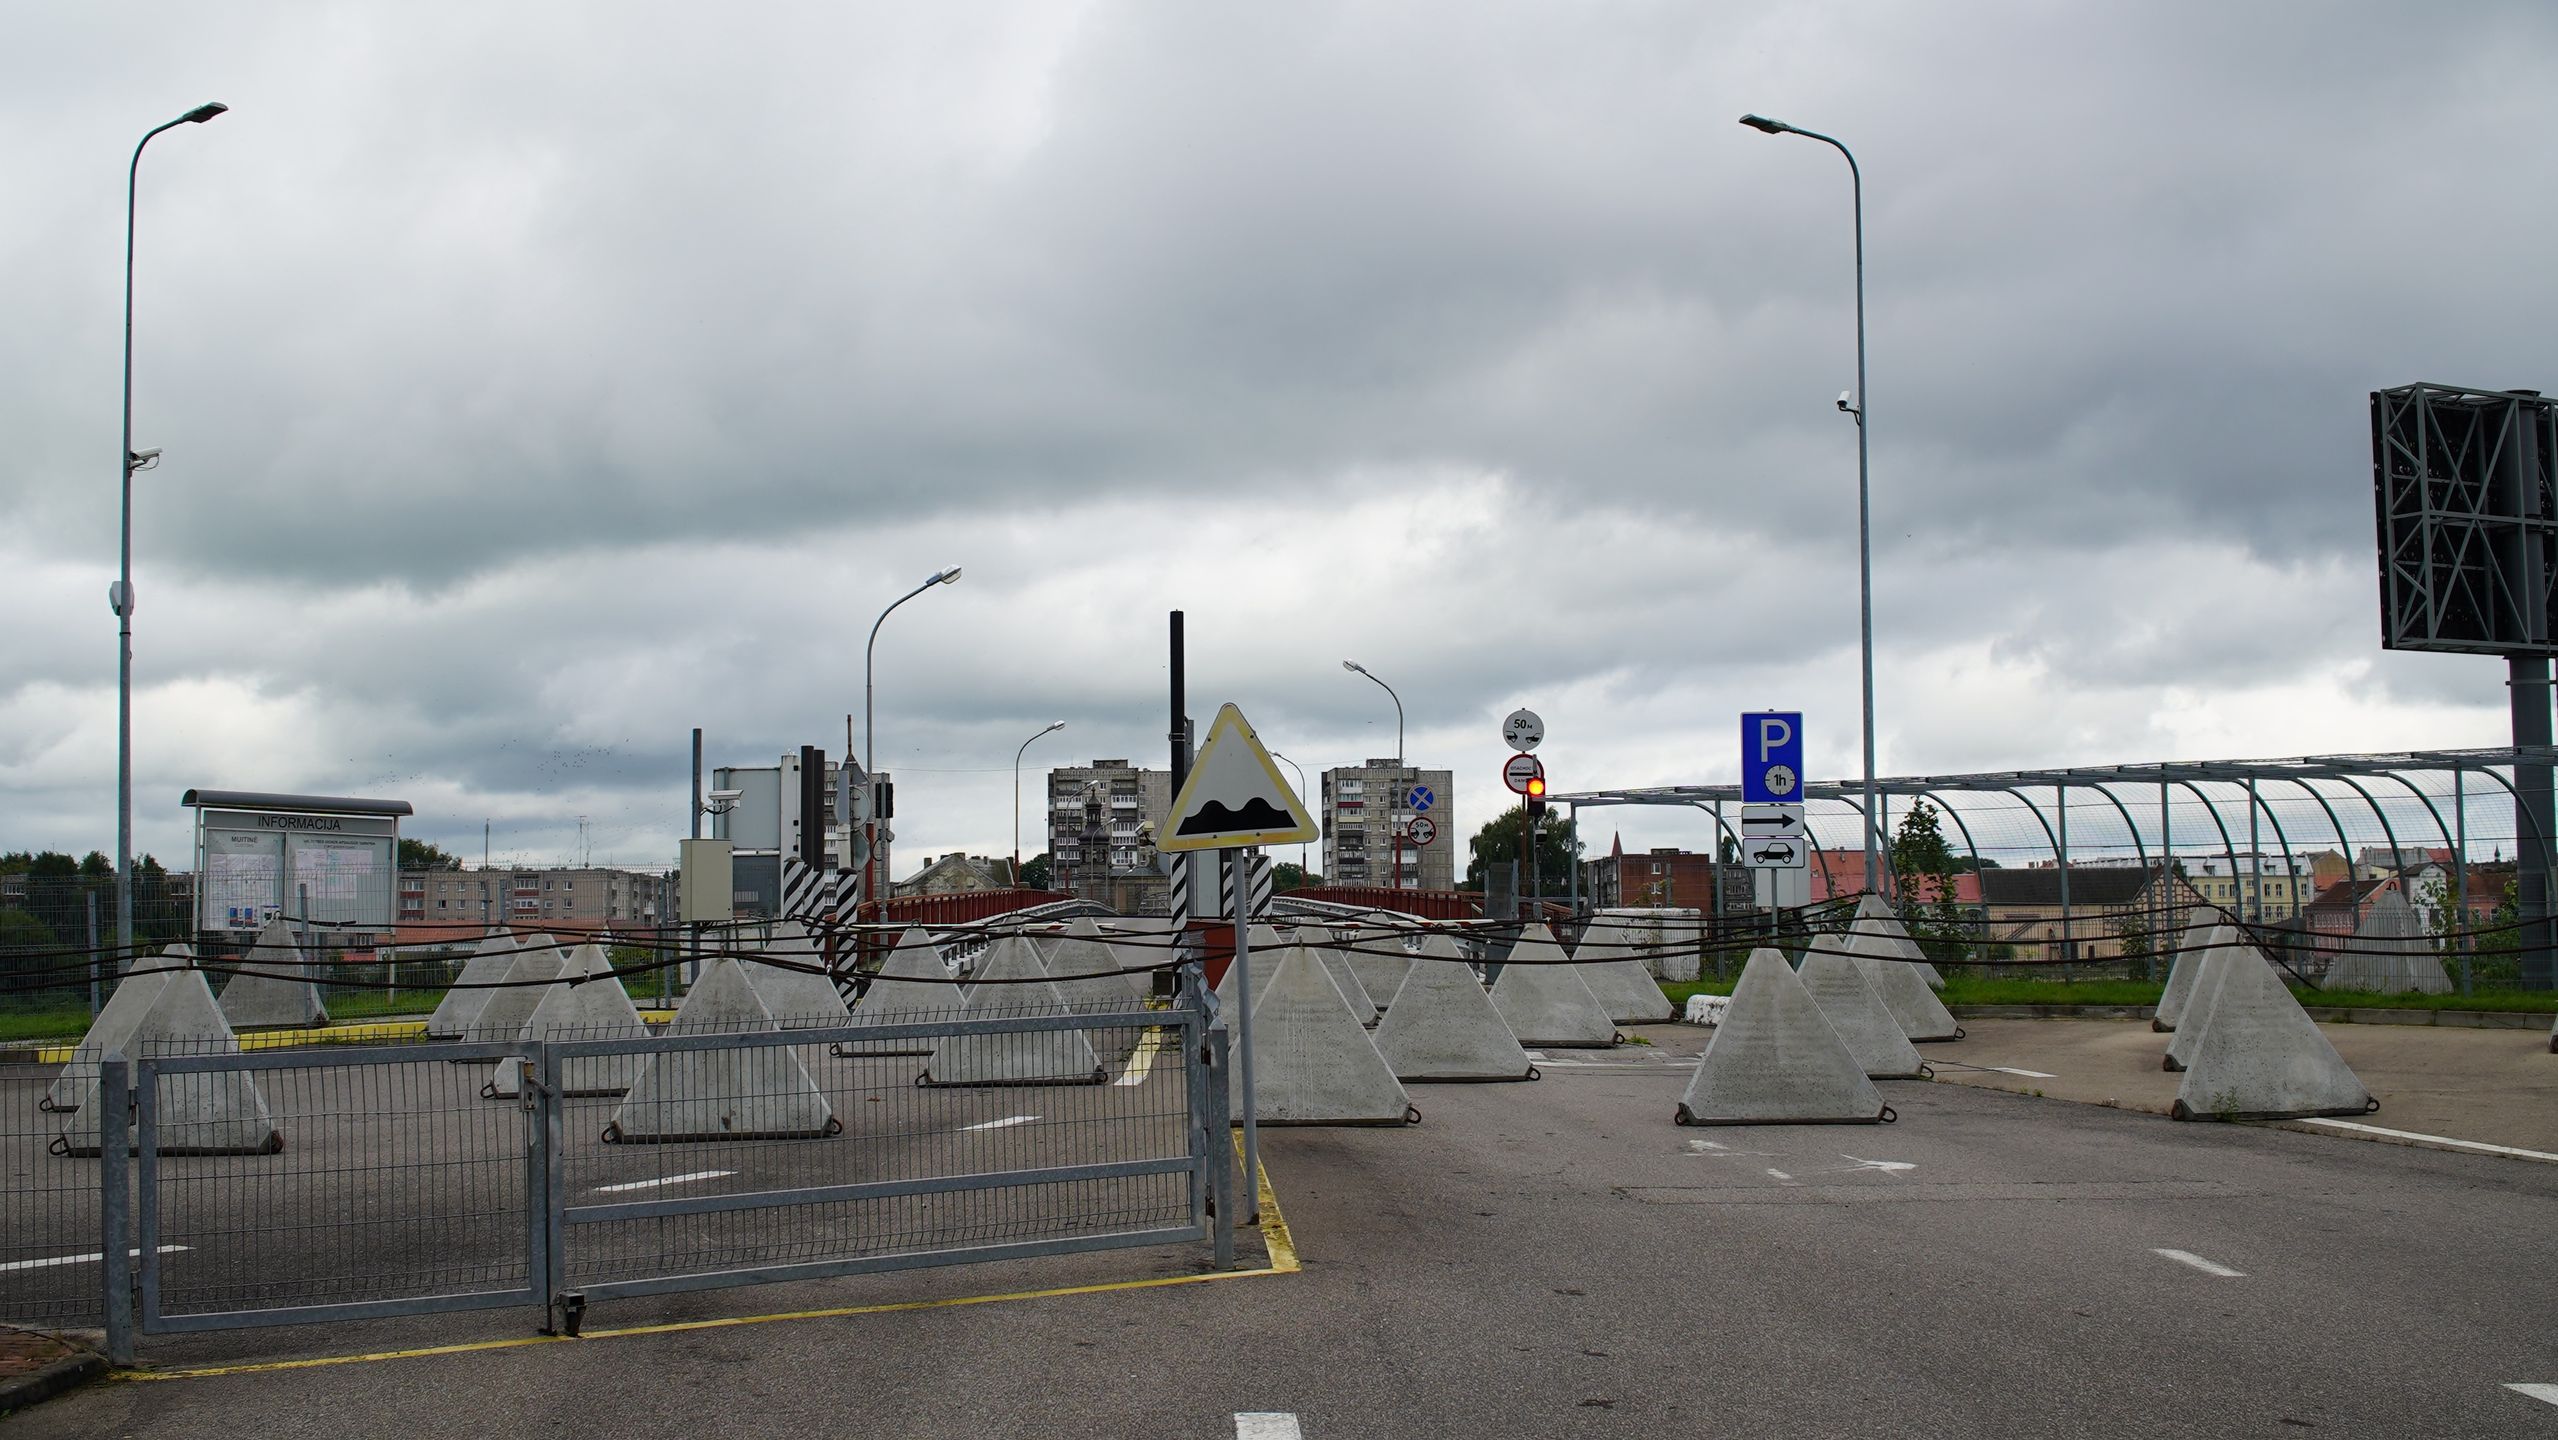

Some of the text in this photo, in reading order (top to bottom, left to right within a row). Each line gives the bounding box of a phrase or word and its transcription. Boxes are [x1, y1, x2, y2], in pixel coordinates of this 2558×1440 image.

[1761, 719, 1791, 762] P
[1774, 774, 1786, 786] 1h
[258, 815, 341, 831] INFORMACIJA
